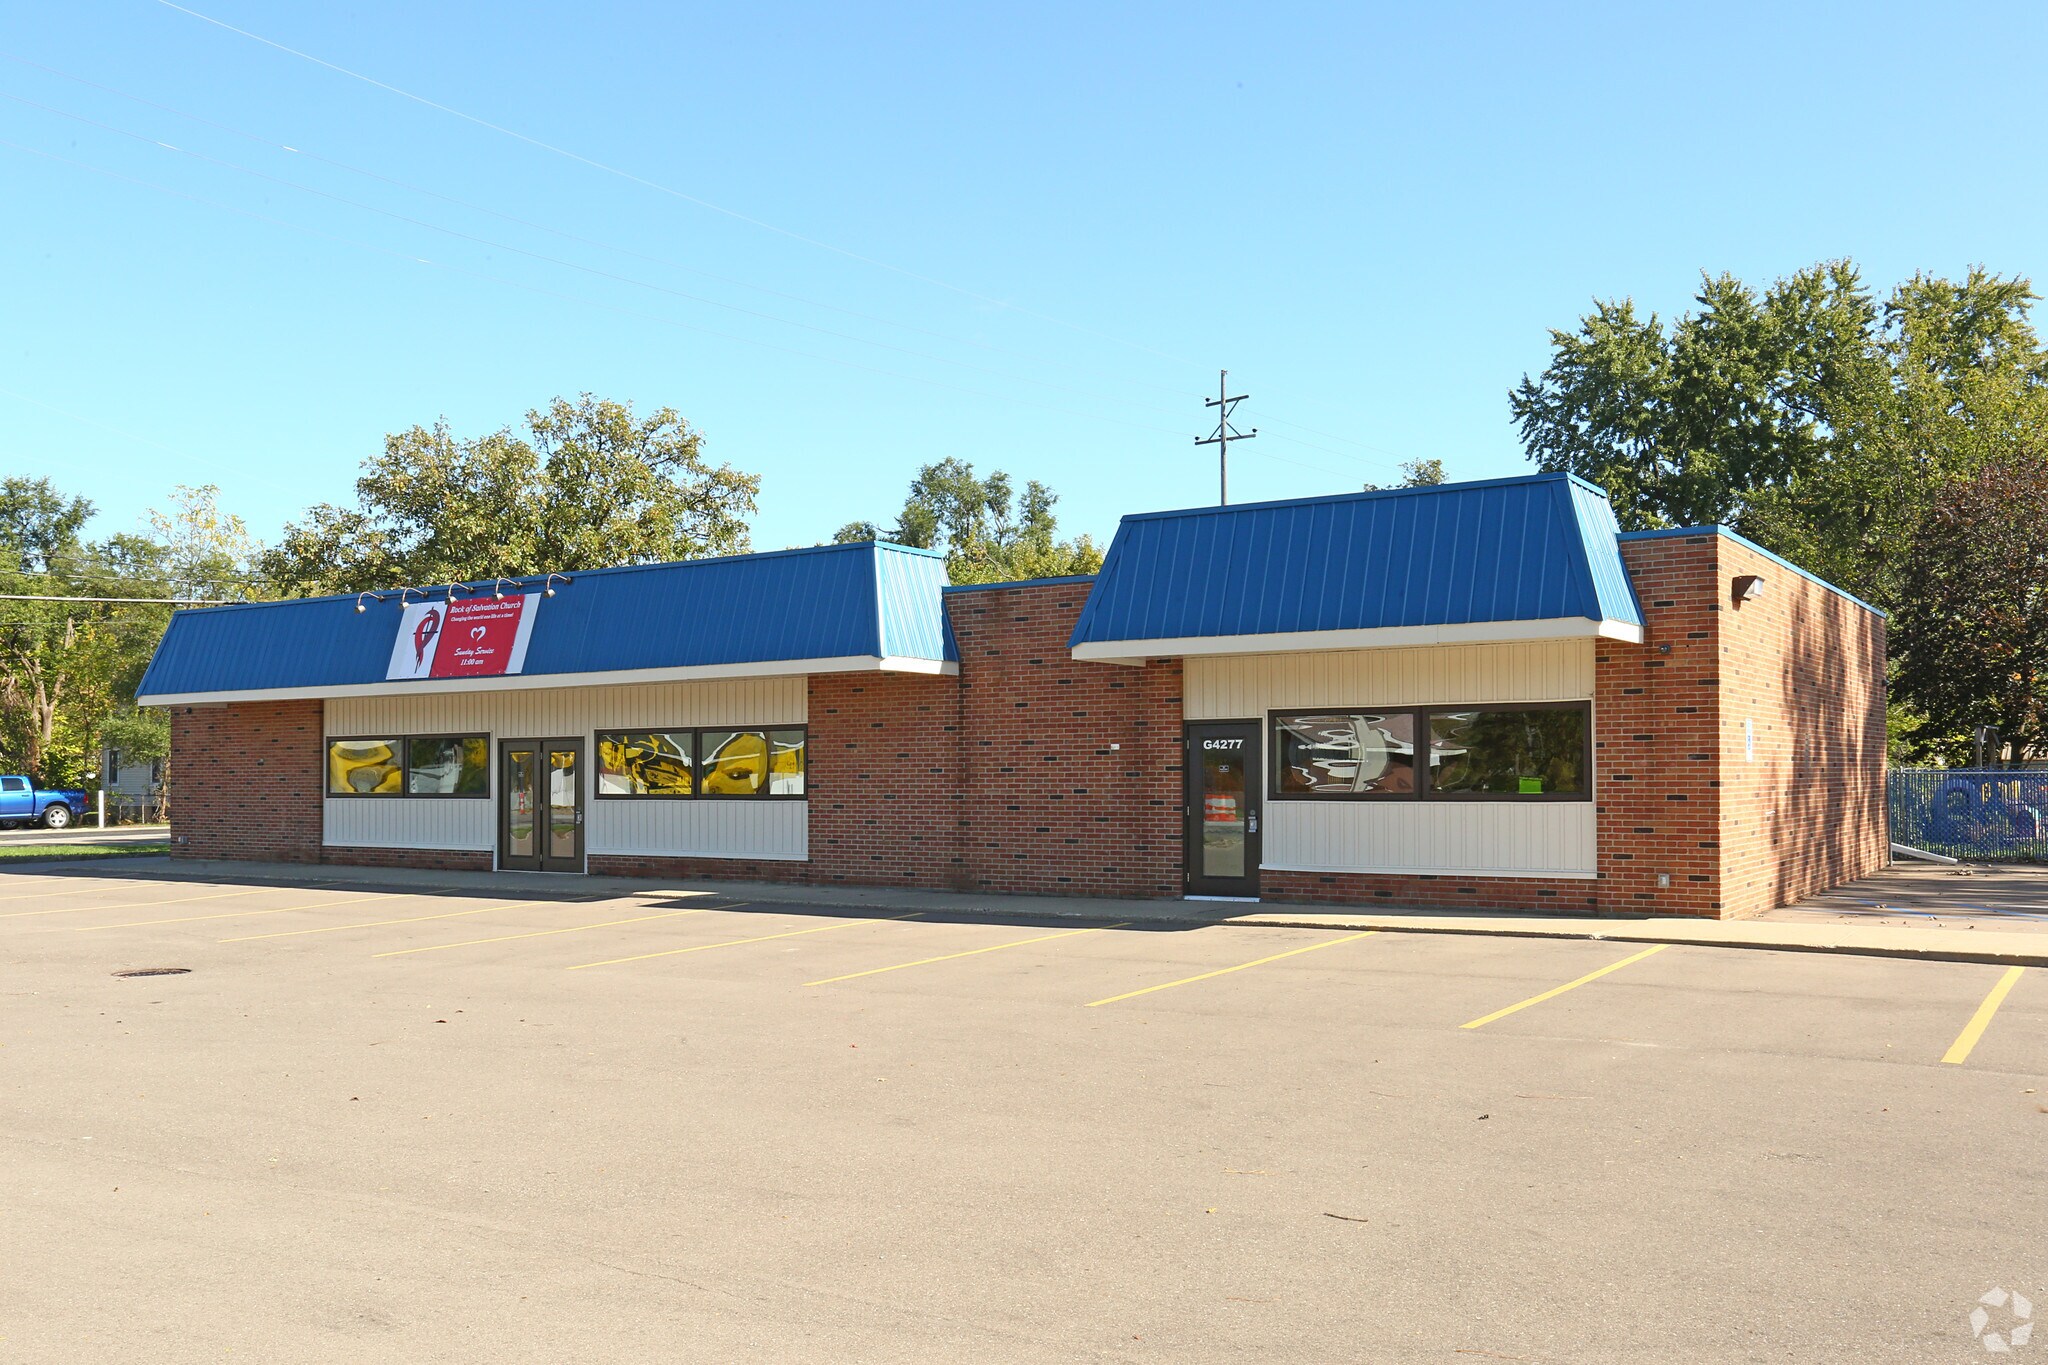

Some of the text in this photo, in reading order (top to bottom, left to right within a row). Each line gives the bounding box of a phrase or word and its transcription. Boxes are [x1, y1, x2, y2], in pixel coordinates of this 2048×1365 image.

[465, 605, 473, 614] of
[472, 603, 499, 611] Salvation
[500, 601, 521, 609] Church
[454, 646, 495, 657] Sunday Service
[461, 658, 475, 666] 11:00
[1203, 739, 1243, 750] G4277
